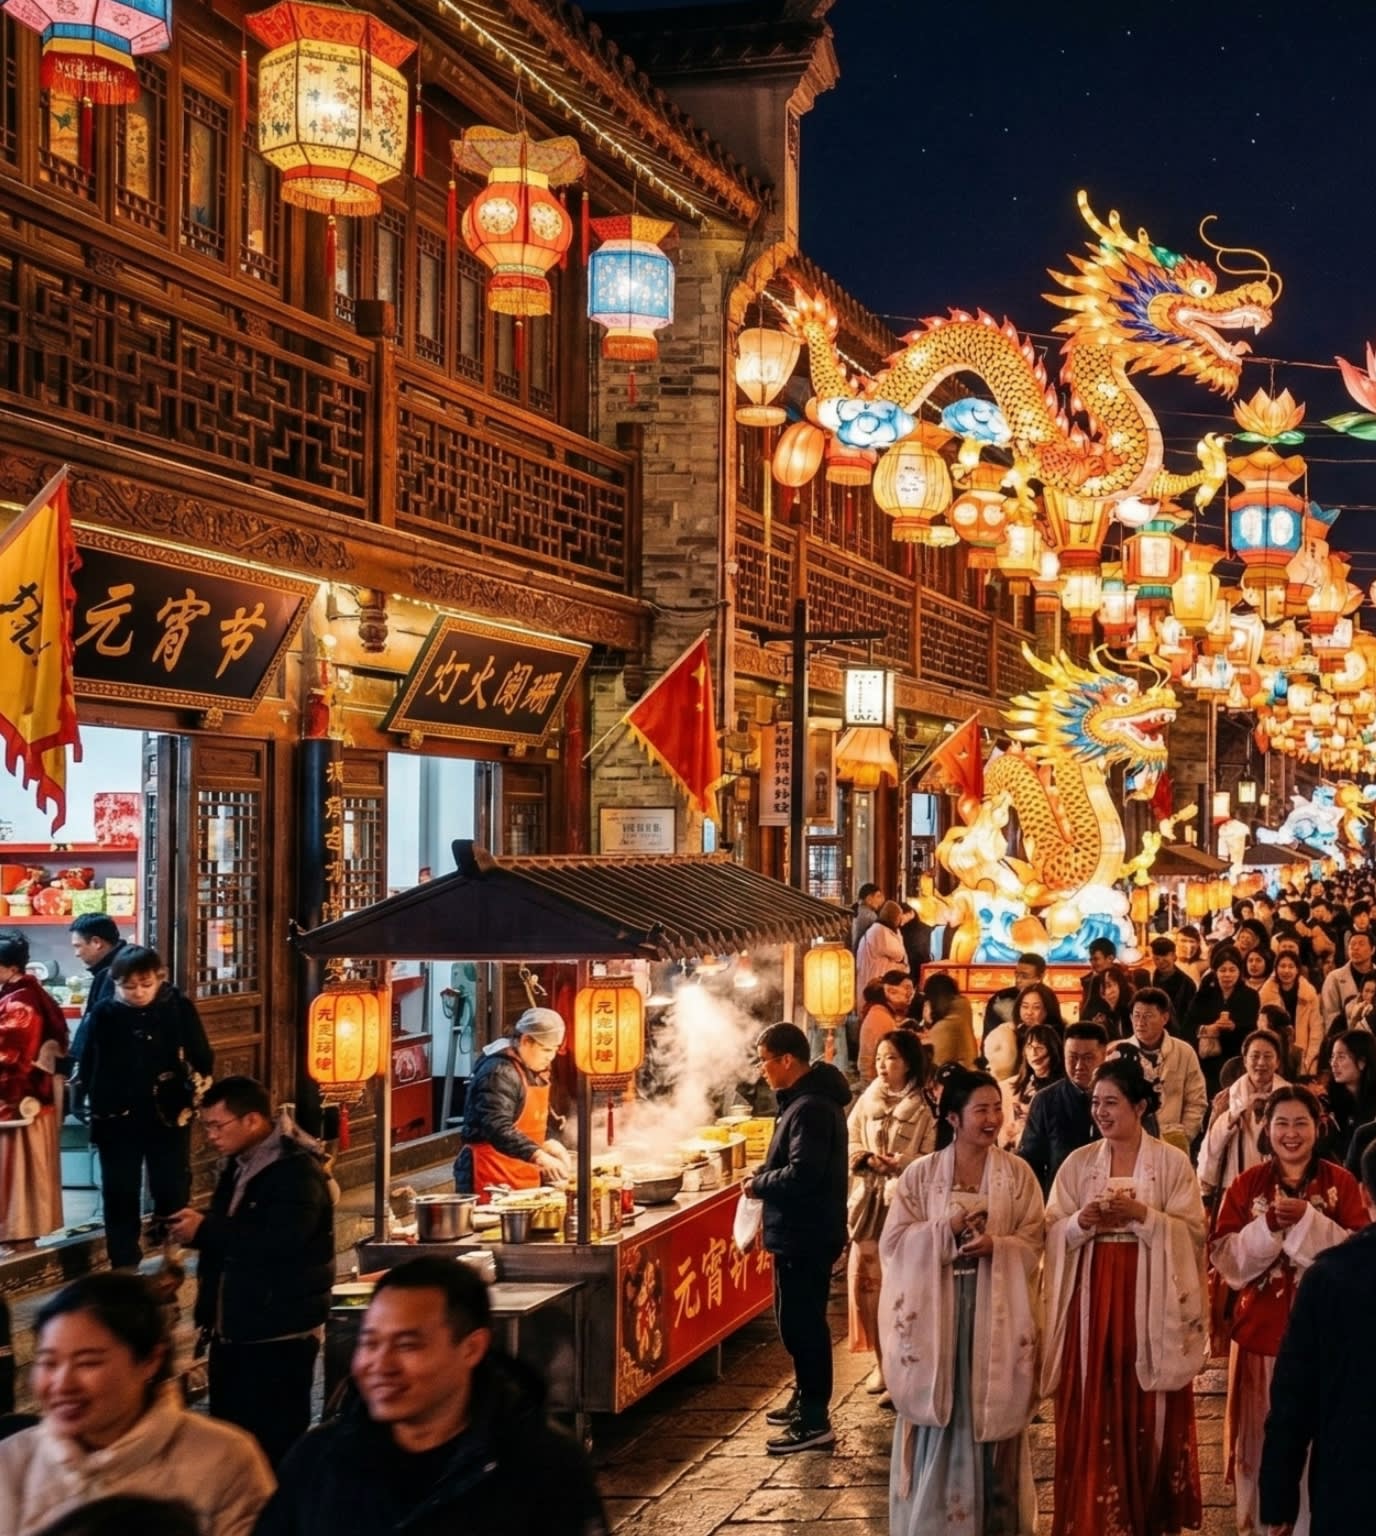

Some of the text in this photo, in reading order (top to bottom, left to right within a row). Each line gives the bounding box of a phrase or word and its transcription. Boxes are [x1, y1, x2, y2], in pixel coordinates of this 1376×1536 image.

[75, 583, 267, 679] 元宵节
[425, 650, 563, 715] 灯火阑珊
